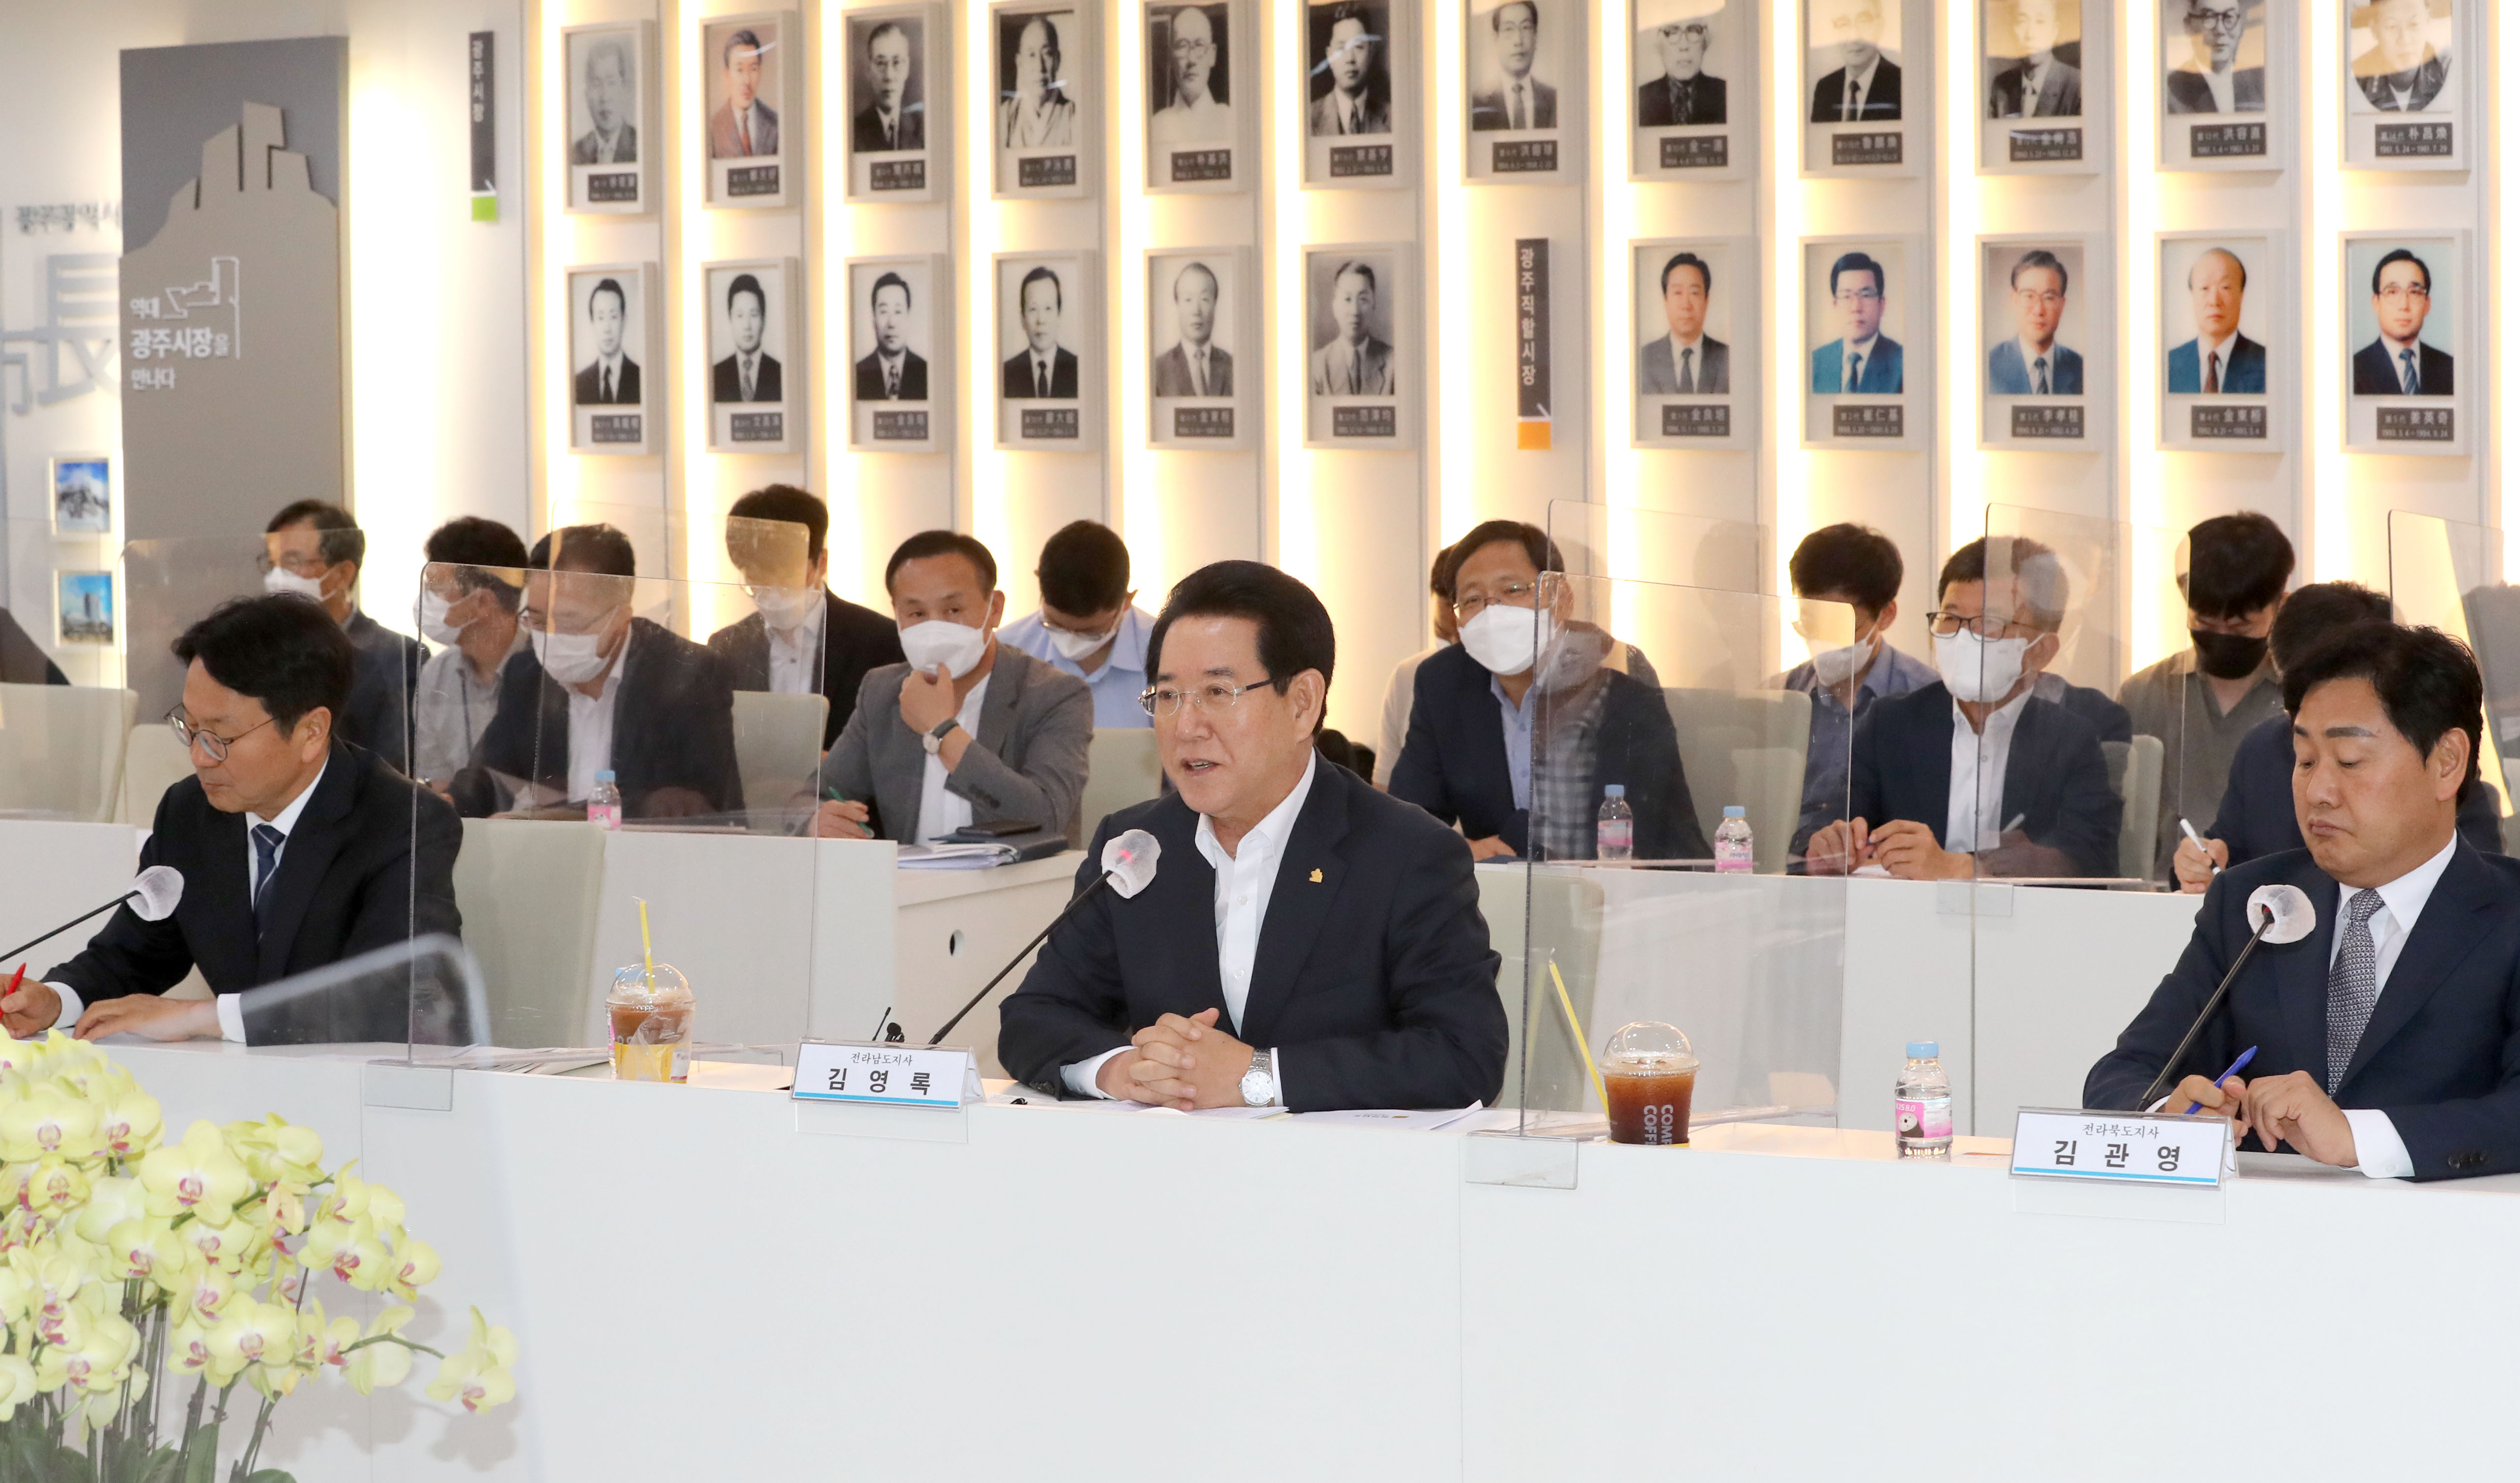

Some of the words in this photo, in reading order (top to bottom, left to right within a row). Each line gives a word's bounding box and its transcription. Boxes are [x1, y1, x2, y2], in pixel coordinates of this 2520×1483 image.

[129, 296, 161, 319] 역대
[1520, 248, 1536, 386] 광주직할시장
[130, 327, 229, 359] 광주시장을
[130, 367, 177, 390] 만나다
[850, 1052, 913, 1067] 전라남도지사
[2082, 1123, 2160, 1139] 전라북도지사
